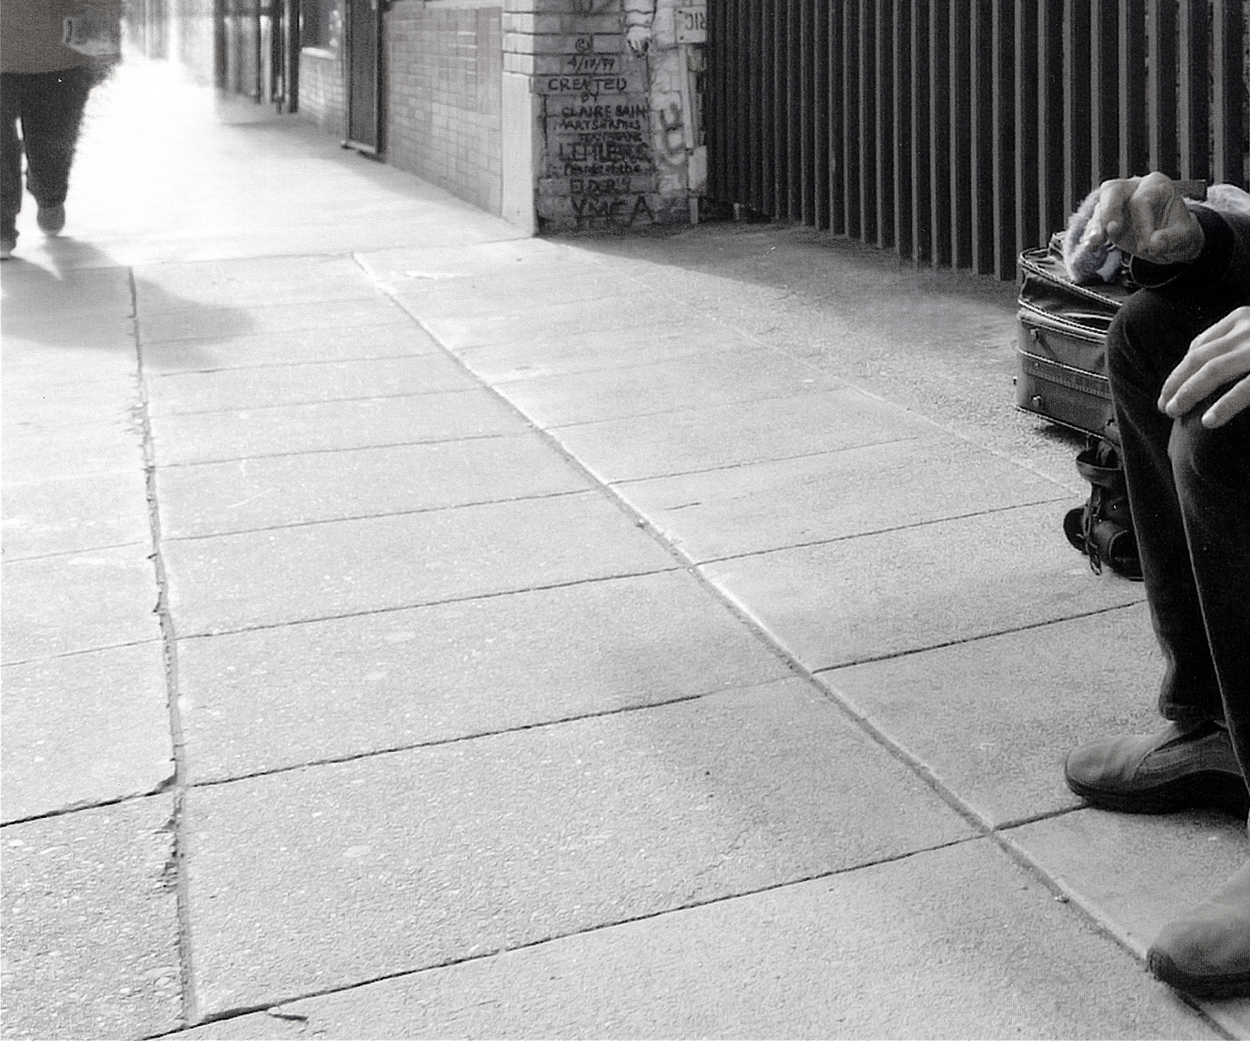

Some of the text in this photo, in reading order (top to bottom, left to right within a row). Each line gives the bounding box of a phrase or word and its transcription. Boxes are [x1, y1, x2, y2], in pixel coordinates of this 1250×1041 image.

[548, 77, 628, 93] CREATED
[580, 91, 600, 103] BY
[561, 104, 612, 119] CLAIRE
